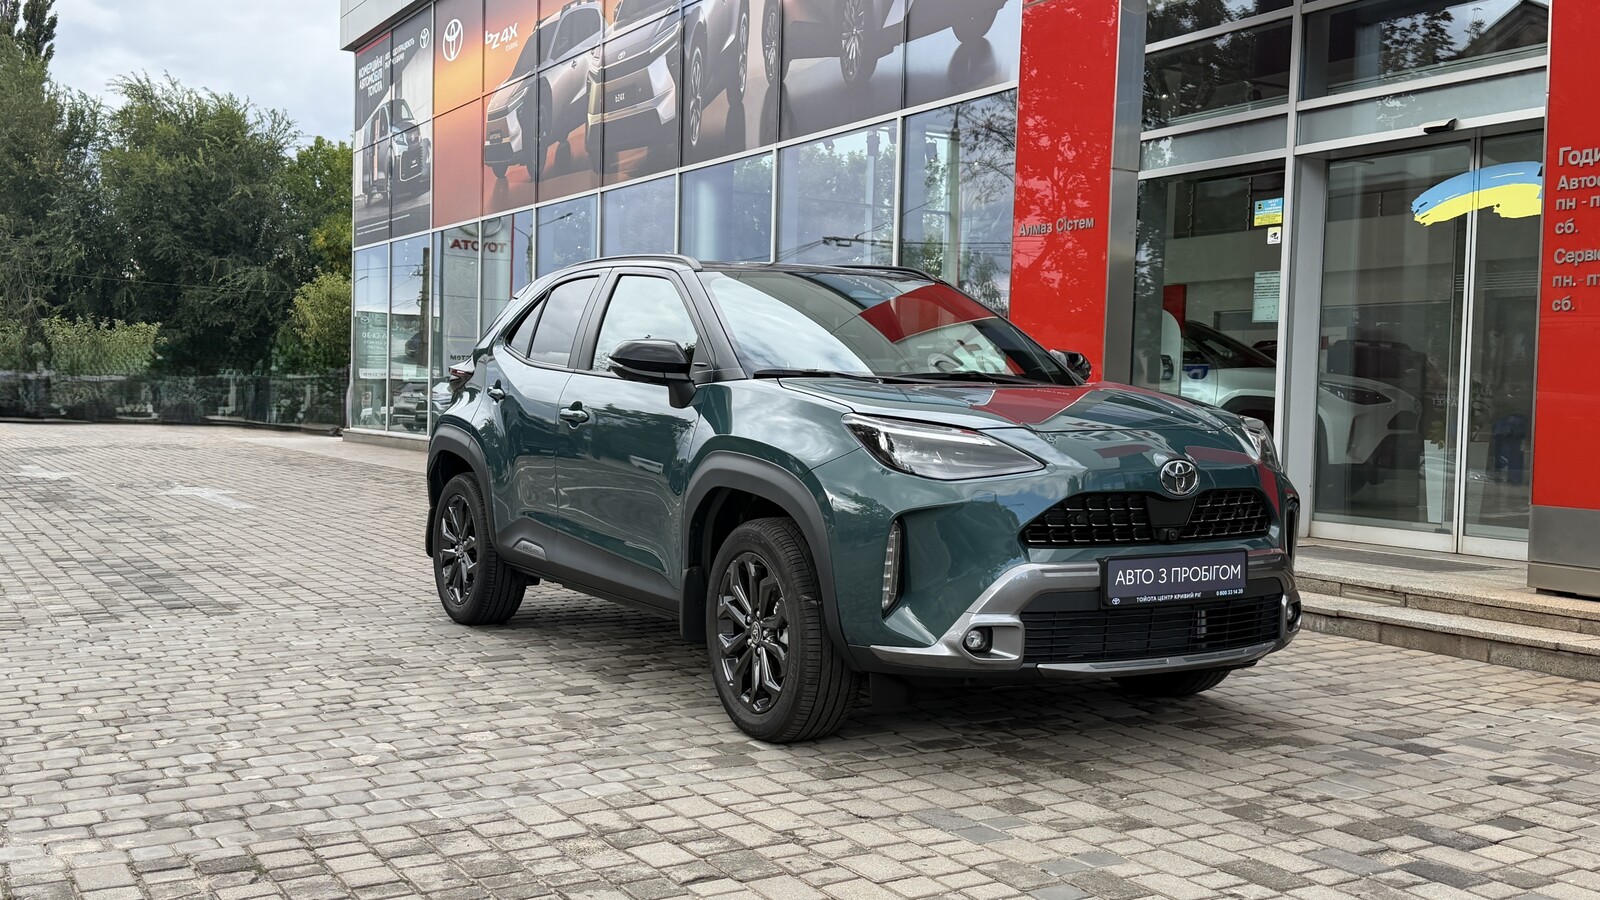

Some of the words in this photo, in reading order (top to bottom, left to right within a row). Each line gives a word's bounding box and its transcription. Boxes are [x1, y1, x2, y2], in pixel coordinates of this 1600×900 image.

[1555, 197, 1577, 211] пн
[1019, 222, 1053, 236] Алмаз
[1056, 217, 1095, 232] Сістем
[1555, 217, 1579, 235] сб.
[1552, 275, 1577, 288] пн.
[1551, 295, 1575, 311] сб.
[1115, 568, 1154, 585] АВТО
[1171, 564, 1241, 583] ПРОБІГОМ
[1136, 595, 1157, 603] ТОЙОТА
[1157, 594, 1173, 602] ЦЕНТР
[1174, 591, 1195, 600] КРИВИЙ
